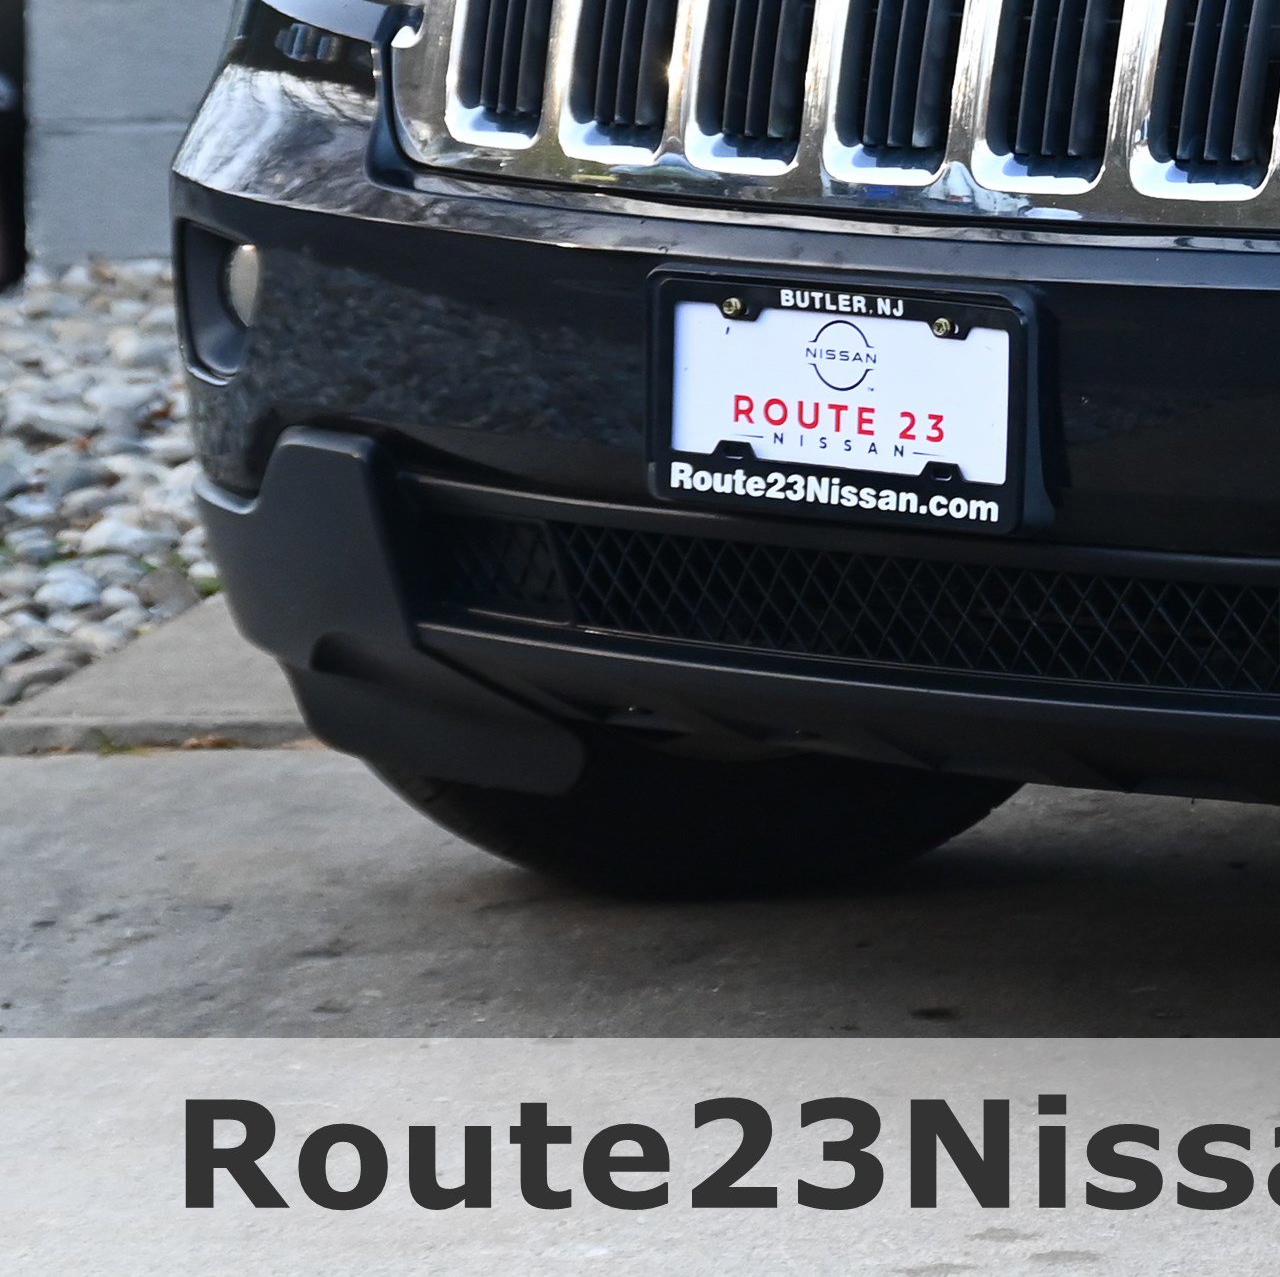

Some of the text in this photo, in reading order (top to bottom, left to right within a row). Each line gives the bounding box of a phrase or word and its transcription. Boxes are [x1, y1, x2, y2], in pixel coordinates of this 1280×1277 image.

[780, 289, 904, 317] BUTLER, NJ
[805, 347, 877, 364] NISSAN
[734, 394, 945, 443] ROUTE 23
[773, 432, 905, 458] NISSAN
[670, 461, 999, 522] Route23Nissan.com
